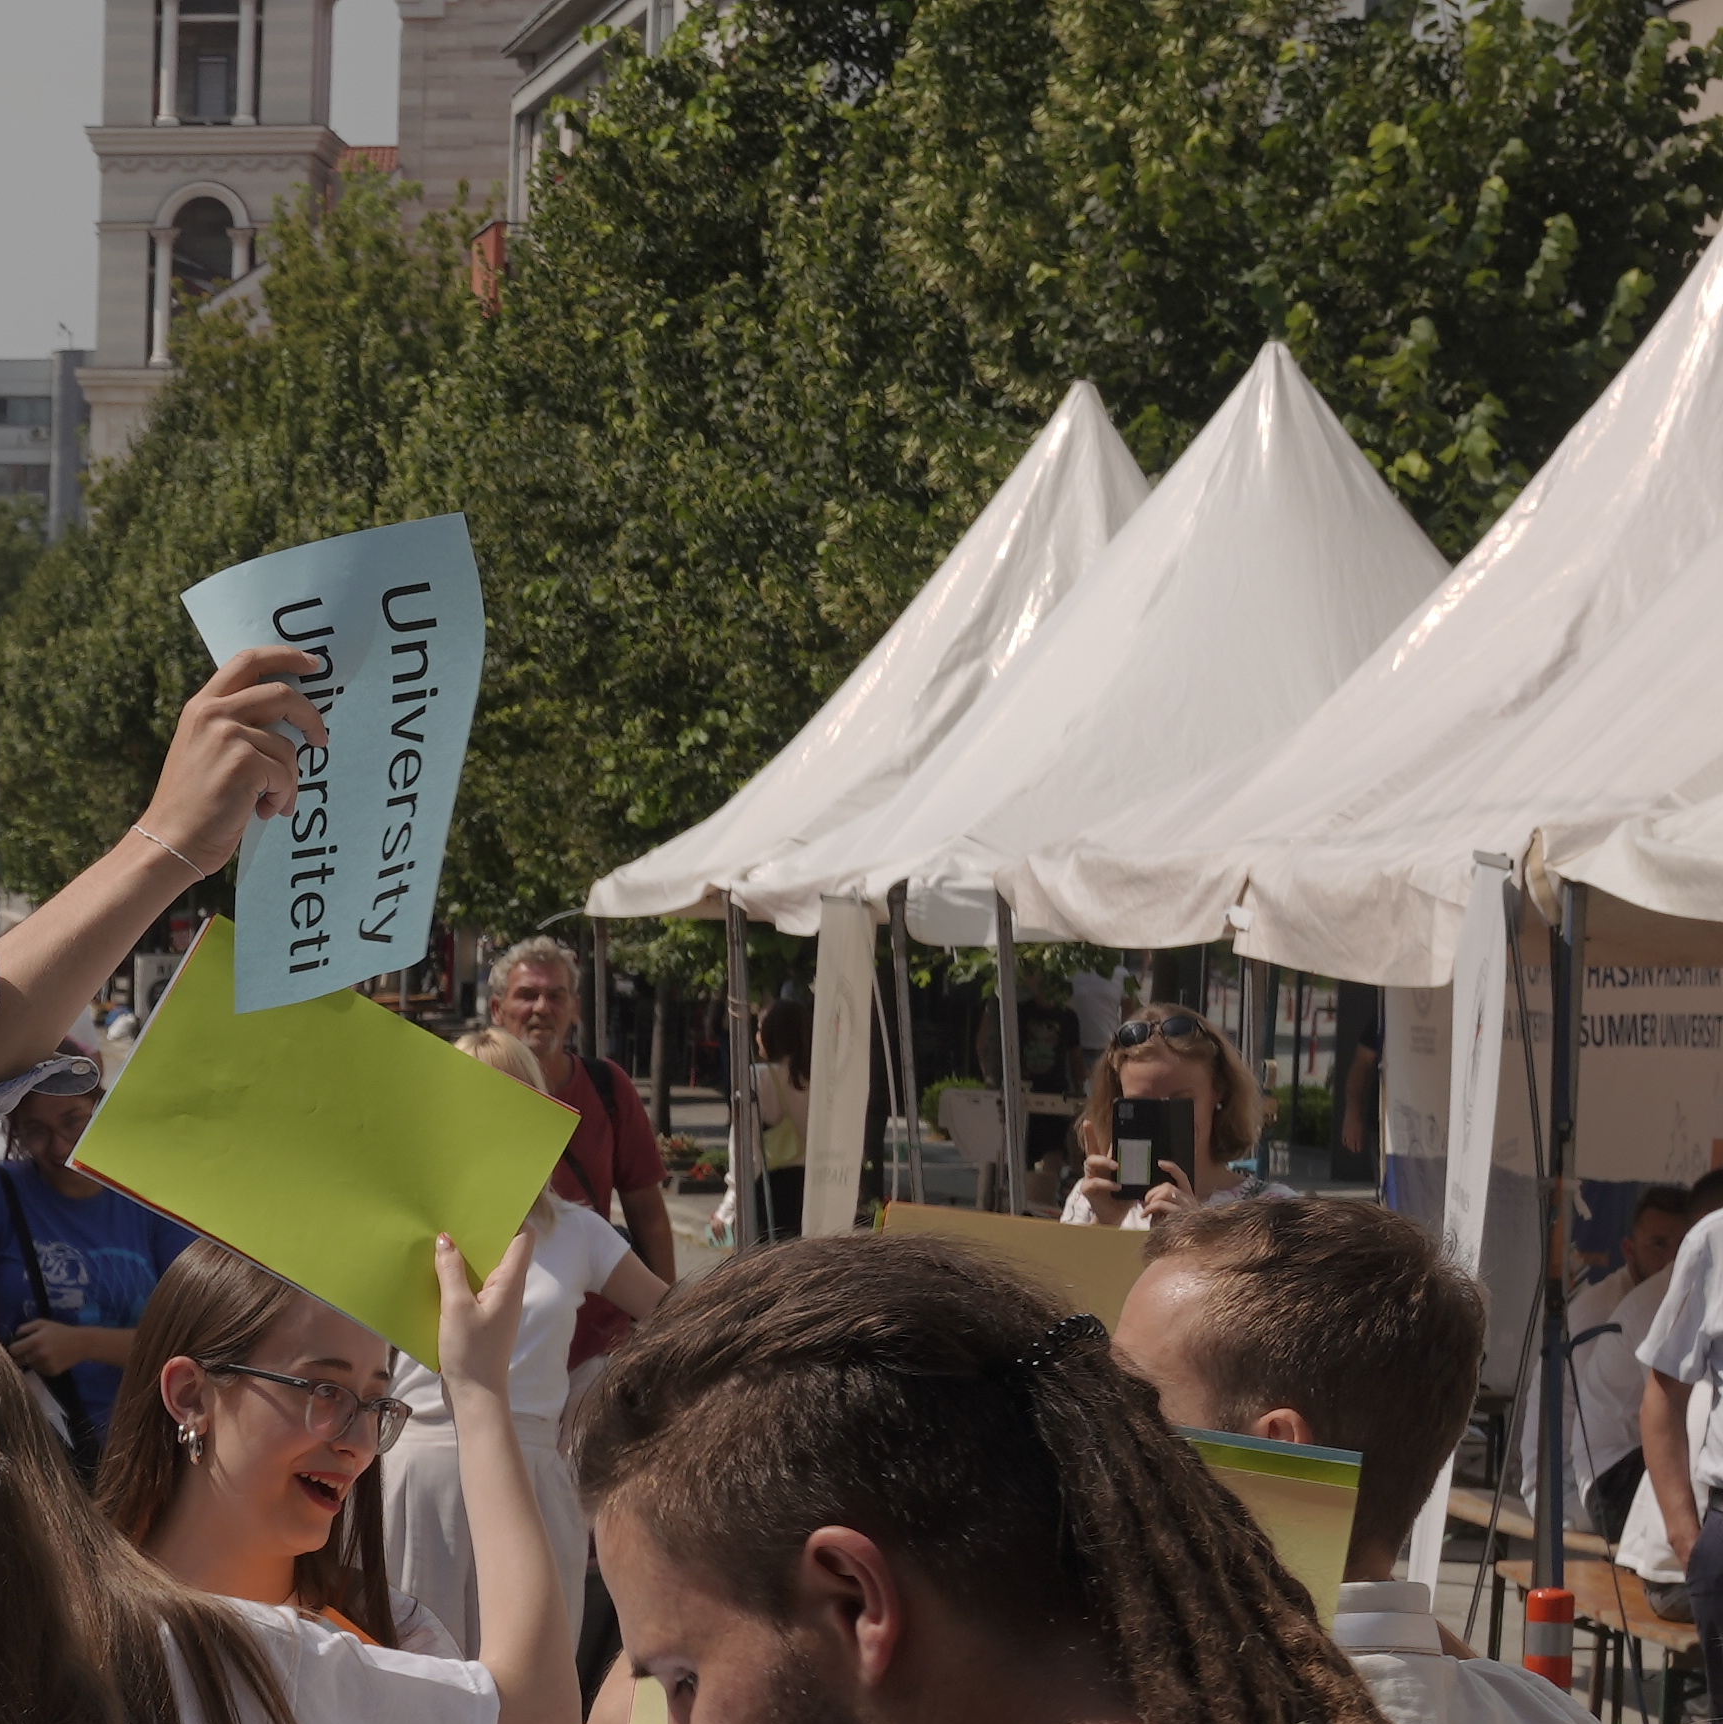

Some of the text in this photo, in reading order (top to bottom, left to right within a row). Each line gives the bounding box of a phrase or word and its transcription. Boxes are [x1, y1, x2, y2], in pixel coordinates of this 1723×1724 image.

[272, 597, 345, 974] Uniersiteti
[359, 582, 439, 944] University
[1580, 1013, 1657, 1048] SUMMER
